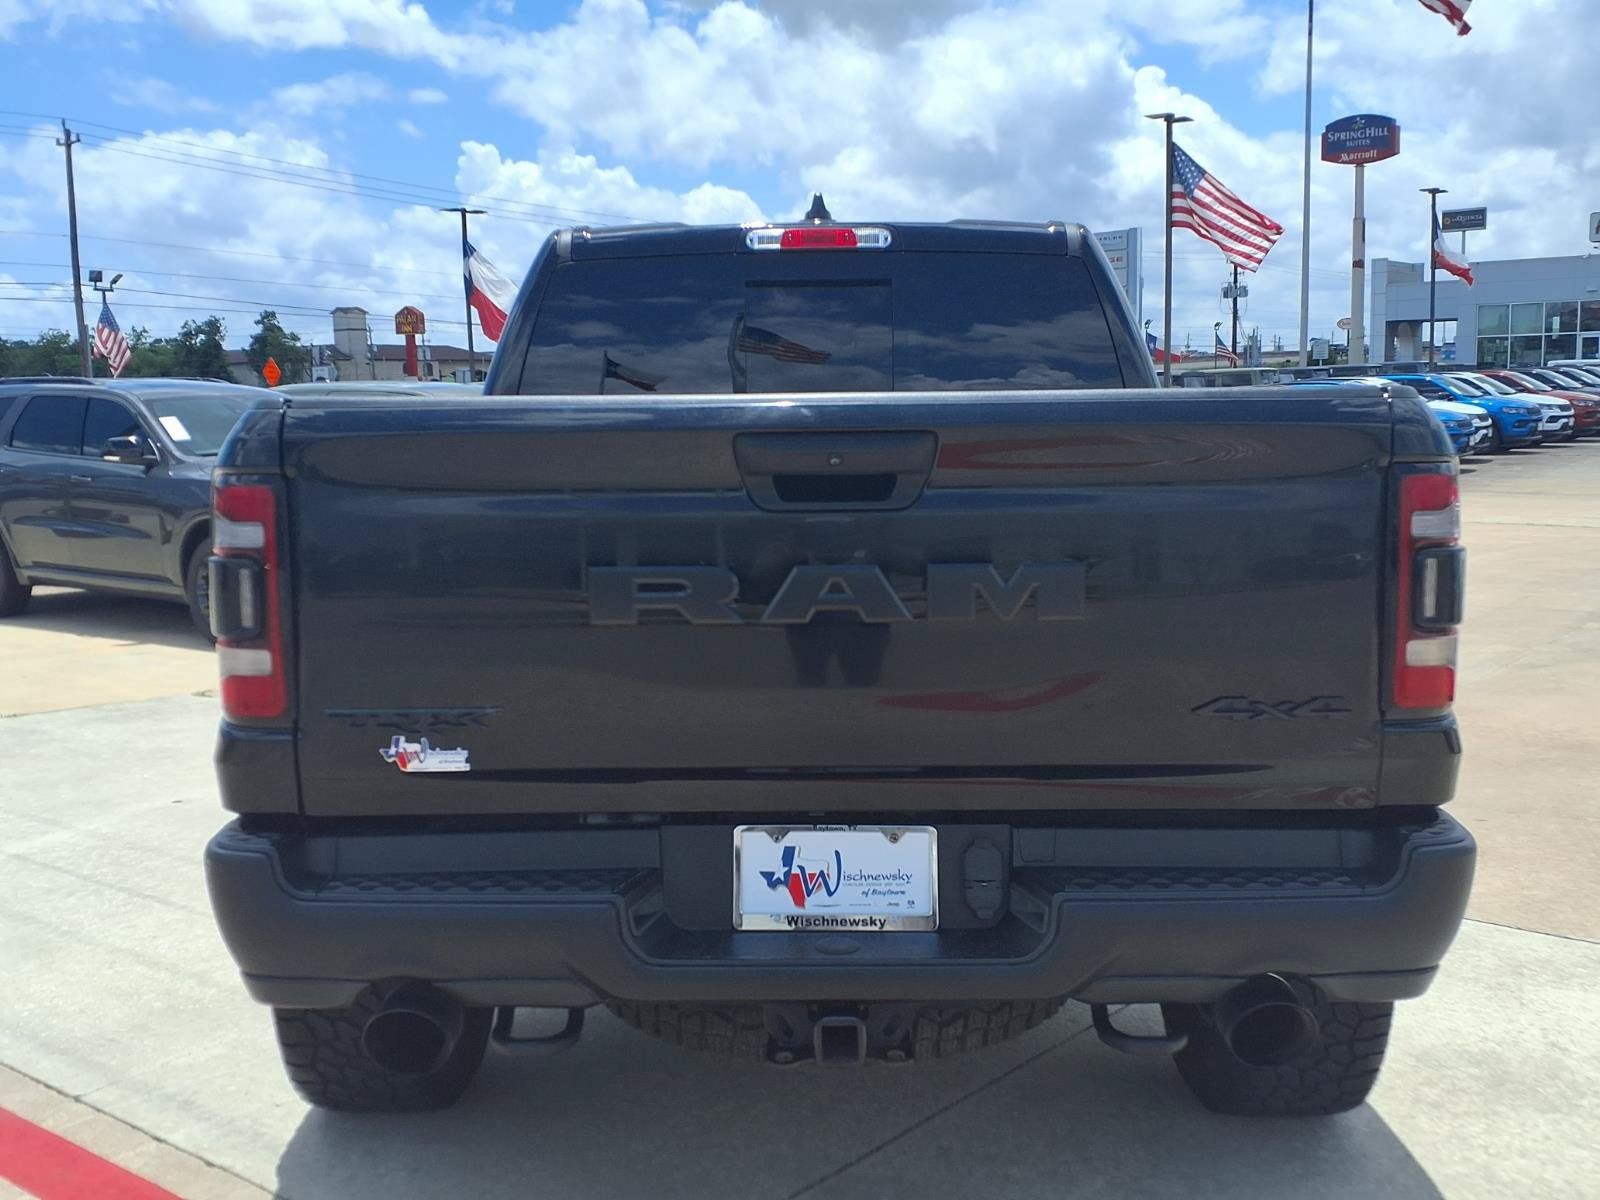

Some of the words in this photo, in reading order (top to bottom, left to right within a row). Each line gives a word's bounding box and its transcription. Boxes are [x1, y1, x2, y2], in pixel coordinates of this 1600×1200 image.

[1339, 150, 1377, 162] Marriott
[588, 564, 1087, 625] RAM
[786, 915, 886, 929] Wischnewsky
